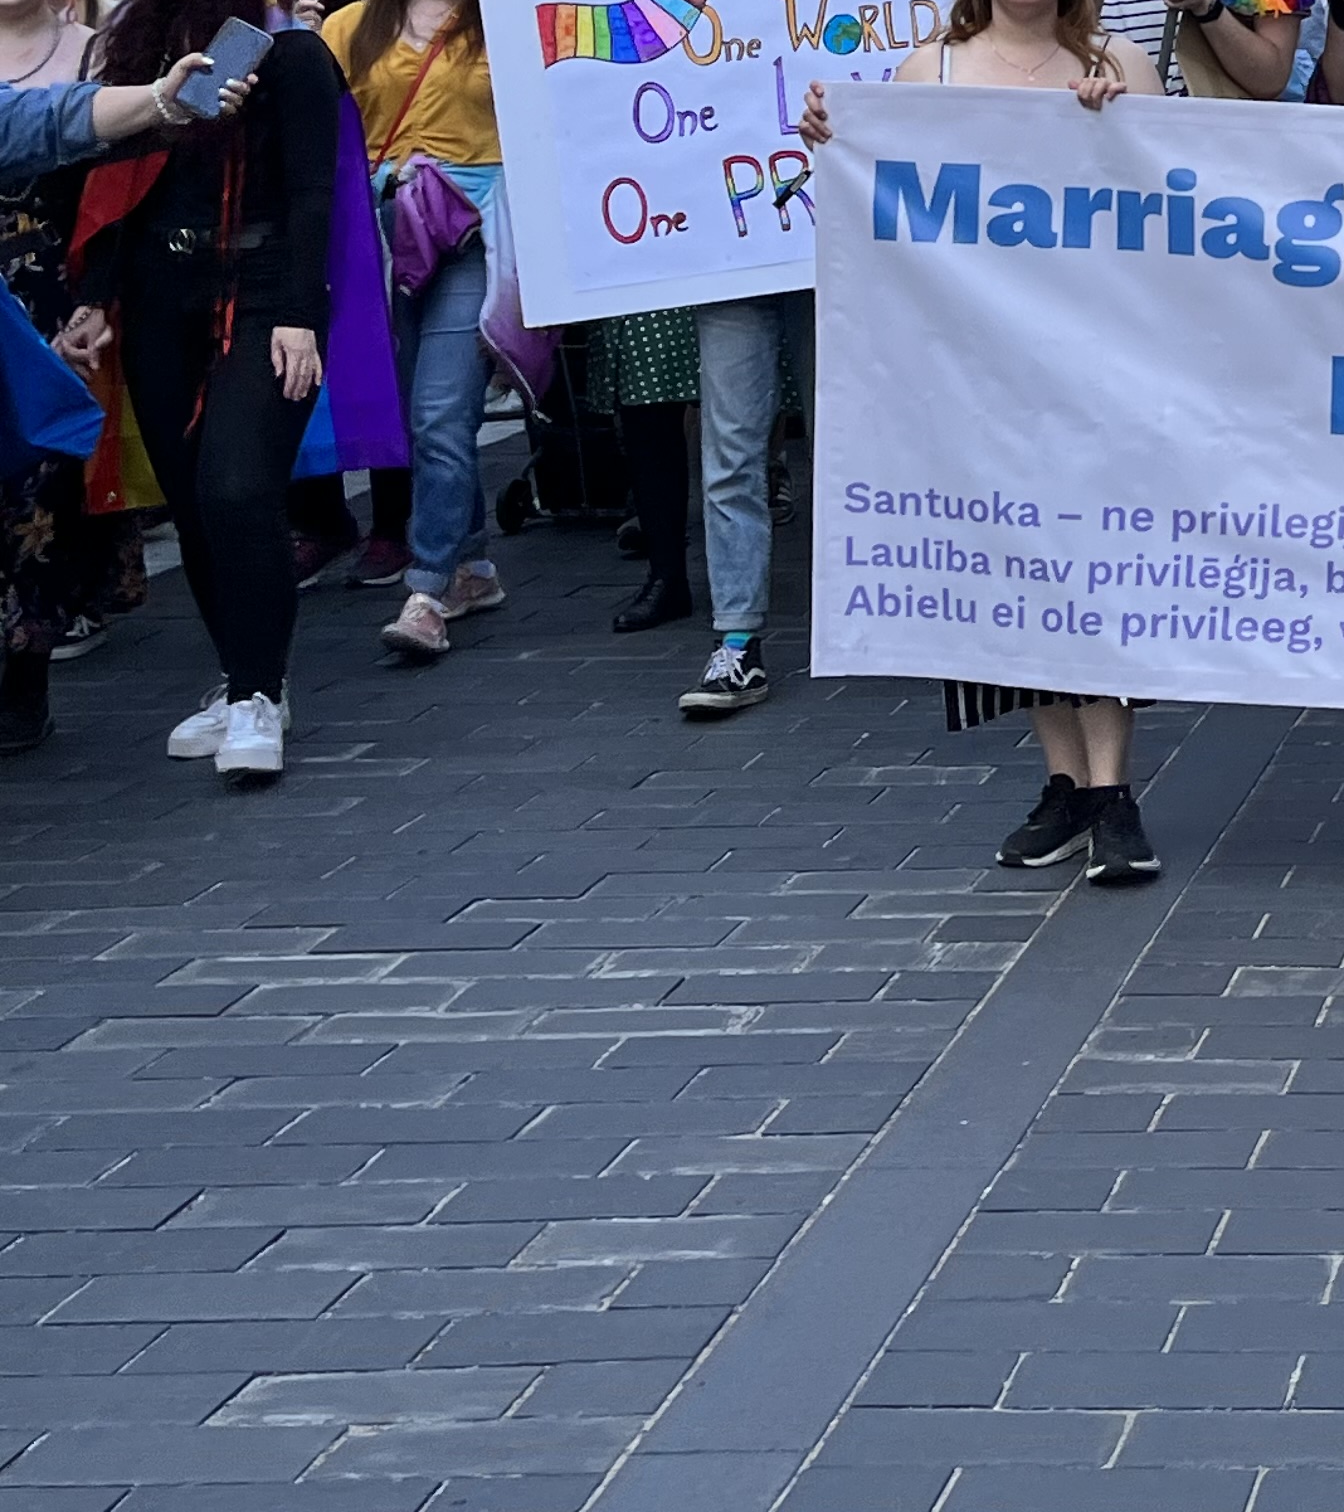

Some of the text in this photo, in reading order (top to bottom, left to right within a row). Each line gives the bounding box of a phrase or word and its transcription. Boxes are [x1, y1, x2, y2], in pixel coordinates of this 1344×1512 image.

[682, 5, 762, 66] One
[633, 81, 719, 143] One
[602, 177, 689, 244] One
[844, 482, 1041, 527] Santuoka
[1102, 505, 1155, 533] ne
[845, 536, 991, 576] Laulība
[1005, 555, 1073, 583] nav
[1088, 553, 1308, 599] privilēģija,
[844, 584, 977, 624] Abielu
[992, 595, 1026, 629] ei
[1041, 601, 1103, 636] ole
[1120, 604, 1323, 654] privileeg,
